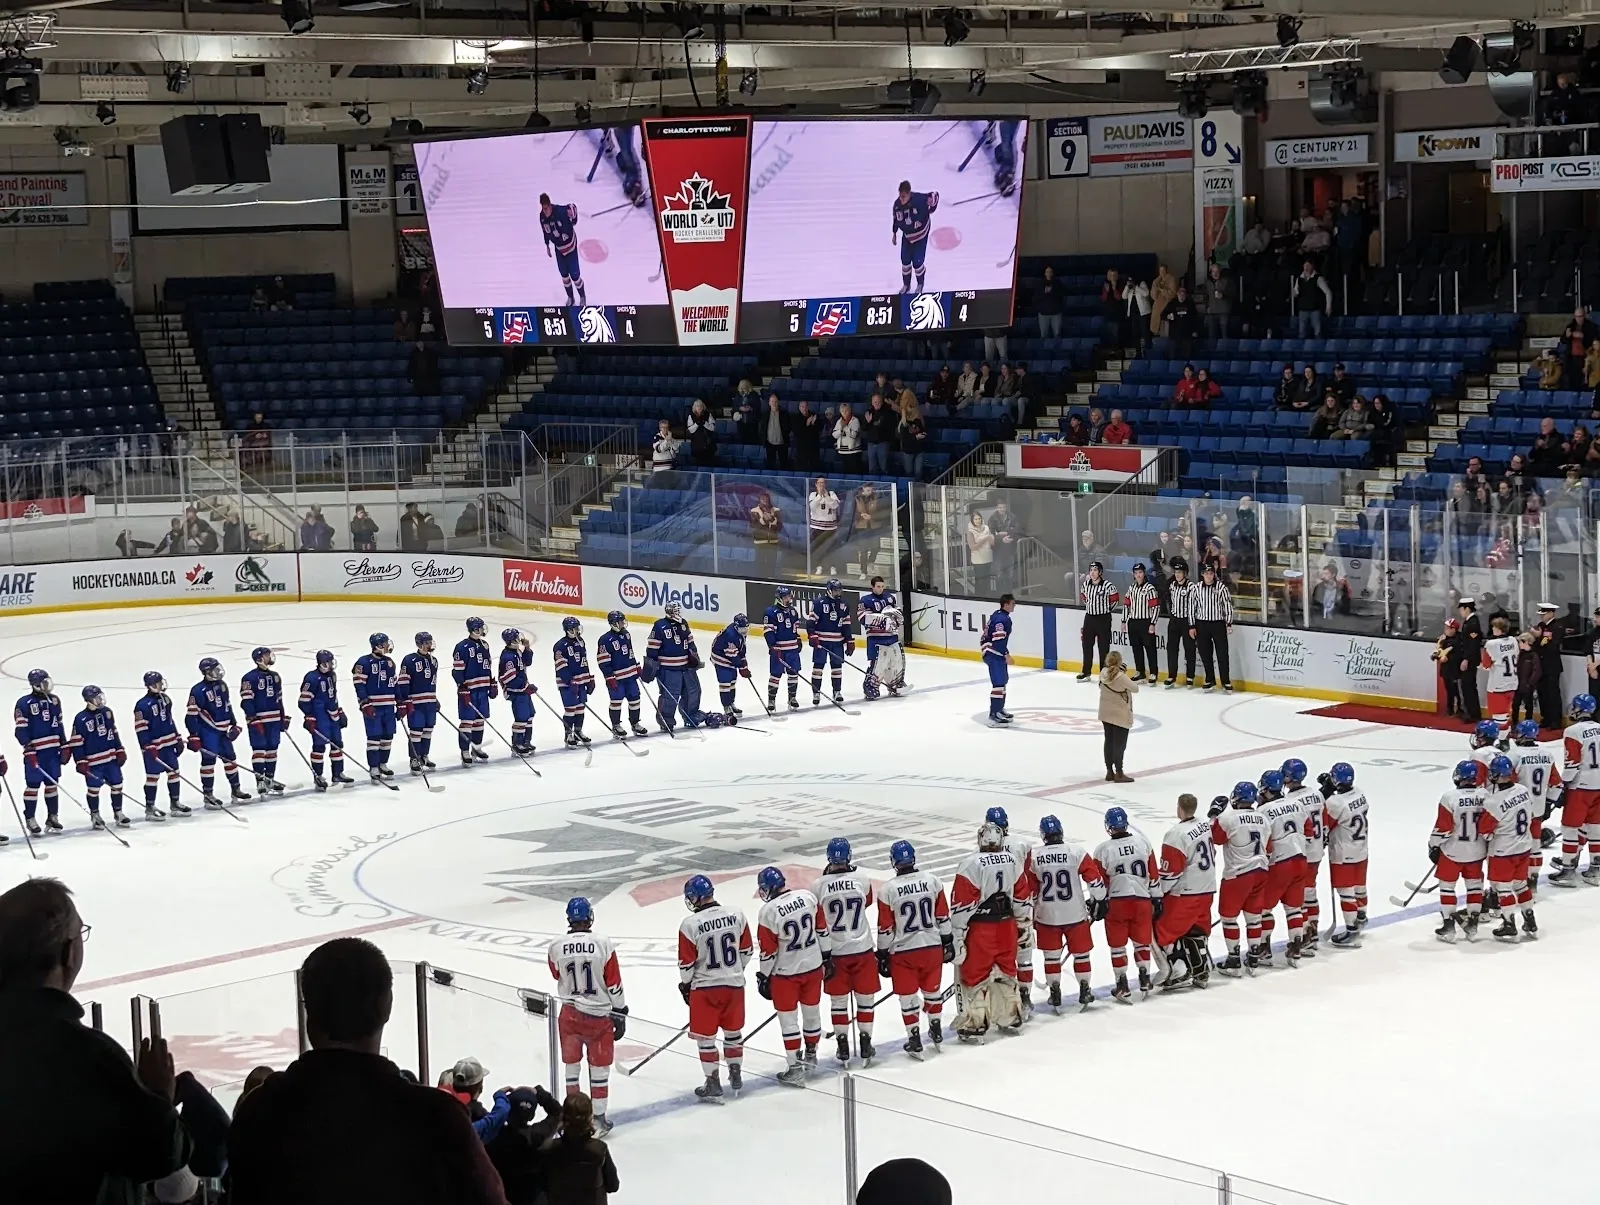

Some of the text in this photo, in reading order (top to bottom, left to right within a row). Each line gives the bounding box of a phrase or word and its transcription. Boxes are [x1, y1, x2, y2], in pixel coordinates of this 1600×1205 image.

[663, 126, 731, 134] CHARLOTTETOWN
[1053, 126, 1082, 136] SECTION
[1201, 120, 1217, 157] 8
[1061, 139, 1076, 171] 9
[1292, 140, 1358, 154] CENTURY 21
[351, 169, 363, 179] M
[374, 168, 386, 179] M
[1496, 163, 1544, 180] PRO POST
[21, 177, 67, 192] Painting
[1204, 177, 1234, 189] VIZZY
[8, 192, 52, 208] Drywall
[663, 212, 734, 229] WORLD U17
[696, 229, 724, 237] CHALLENGE
[682, 306, 729, 319] WELCOMING
[798, 300, 807, 308] 36
[866, 306, 893, 325] 8:51
[958, 304, 968, 322] 4
[484, 321, 492, 338] 5
[543, 318, 567, 336] 8:51
[626, 319, 634, 337] 4
[684, 319, 729, 332] THE WORLD.
[790, 314, 799, 332] 5
[0, 572, 37, 595] ARE
[72, 574, 176, 590] HOCKEYCANADA.CA
[506, 568, 580, 598] Tim Hortons
[0, 594, 33, 607] ERIES
[651, 581, 720, 613] Medals
[1263, 630, 1303, 646] Prince
[1257, 640, 1300, 655] Edward
[1272, 653, 1304, 668] Island
[1532, 768, 1544, 796] 9
[1239, 814, 1264, 825] HOLUB
[1516, 808, 1528, 836] 8
[1119, 845, 1135, 857] LEV
[1249, 831, 1261, 856] 7
[1036, 853, 1068, 866] FASNER
[827, 880, 856, 893] MIKEL
[897, 881, 929, 897] PAVLÍK
[994, 871, 1004, 892] 1
[1042, 869, 1073, 902] 29
[777, 898, 806, 917] ČIHAŘ
[829, 896, 863, 932] 27
[900, 897, 933, 933] 20
[783, 913, 817, 953] 22
[563, 942, 595, 955] FROLO
[705, 932, 738, 970] 16
[566, 961, 597, 996] 11
